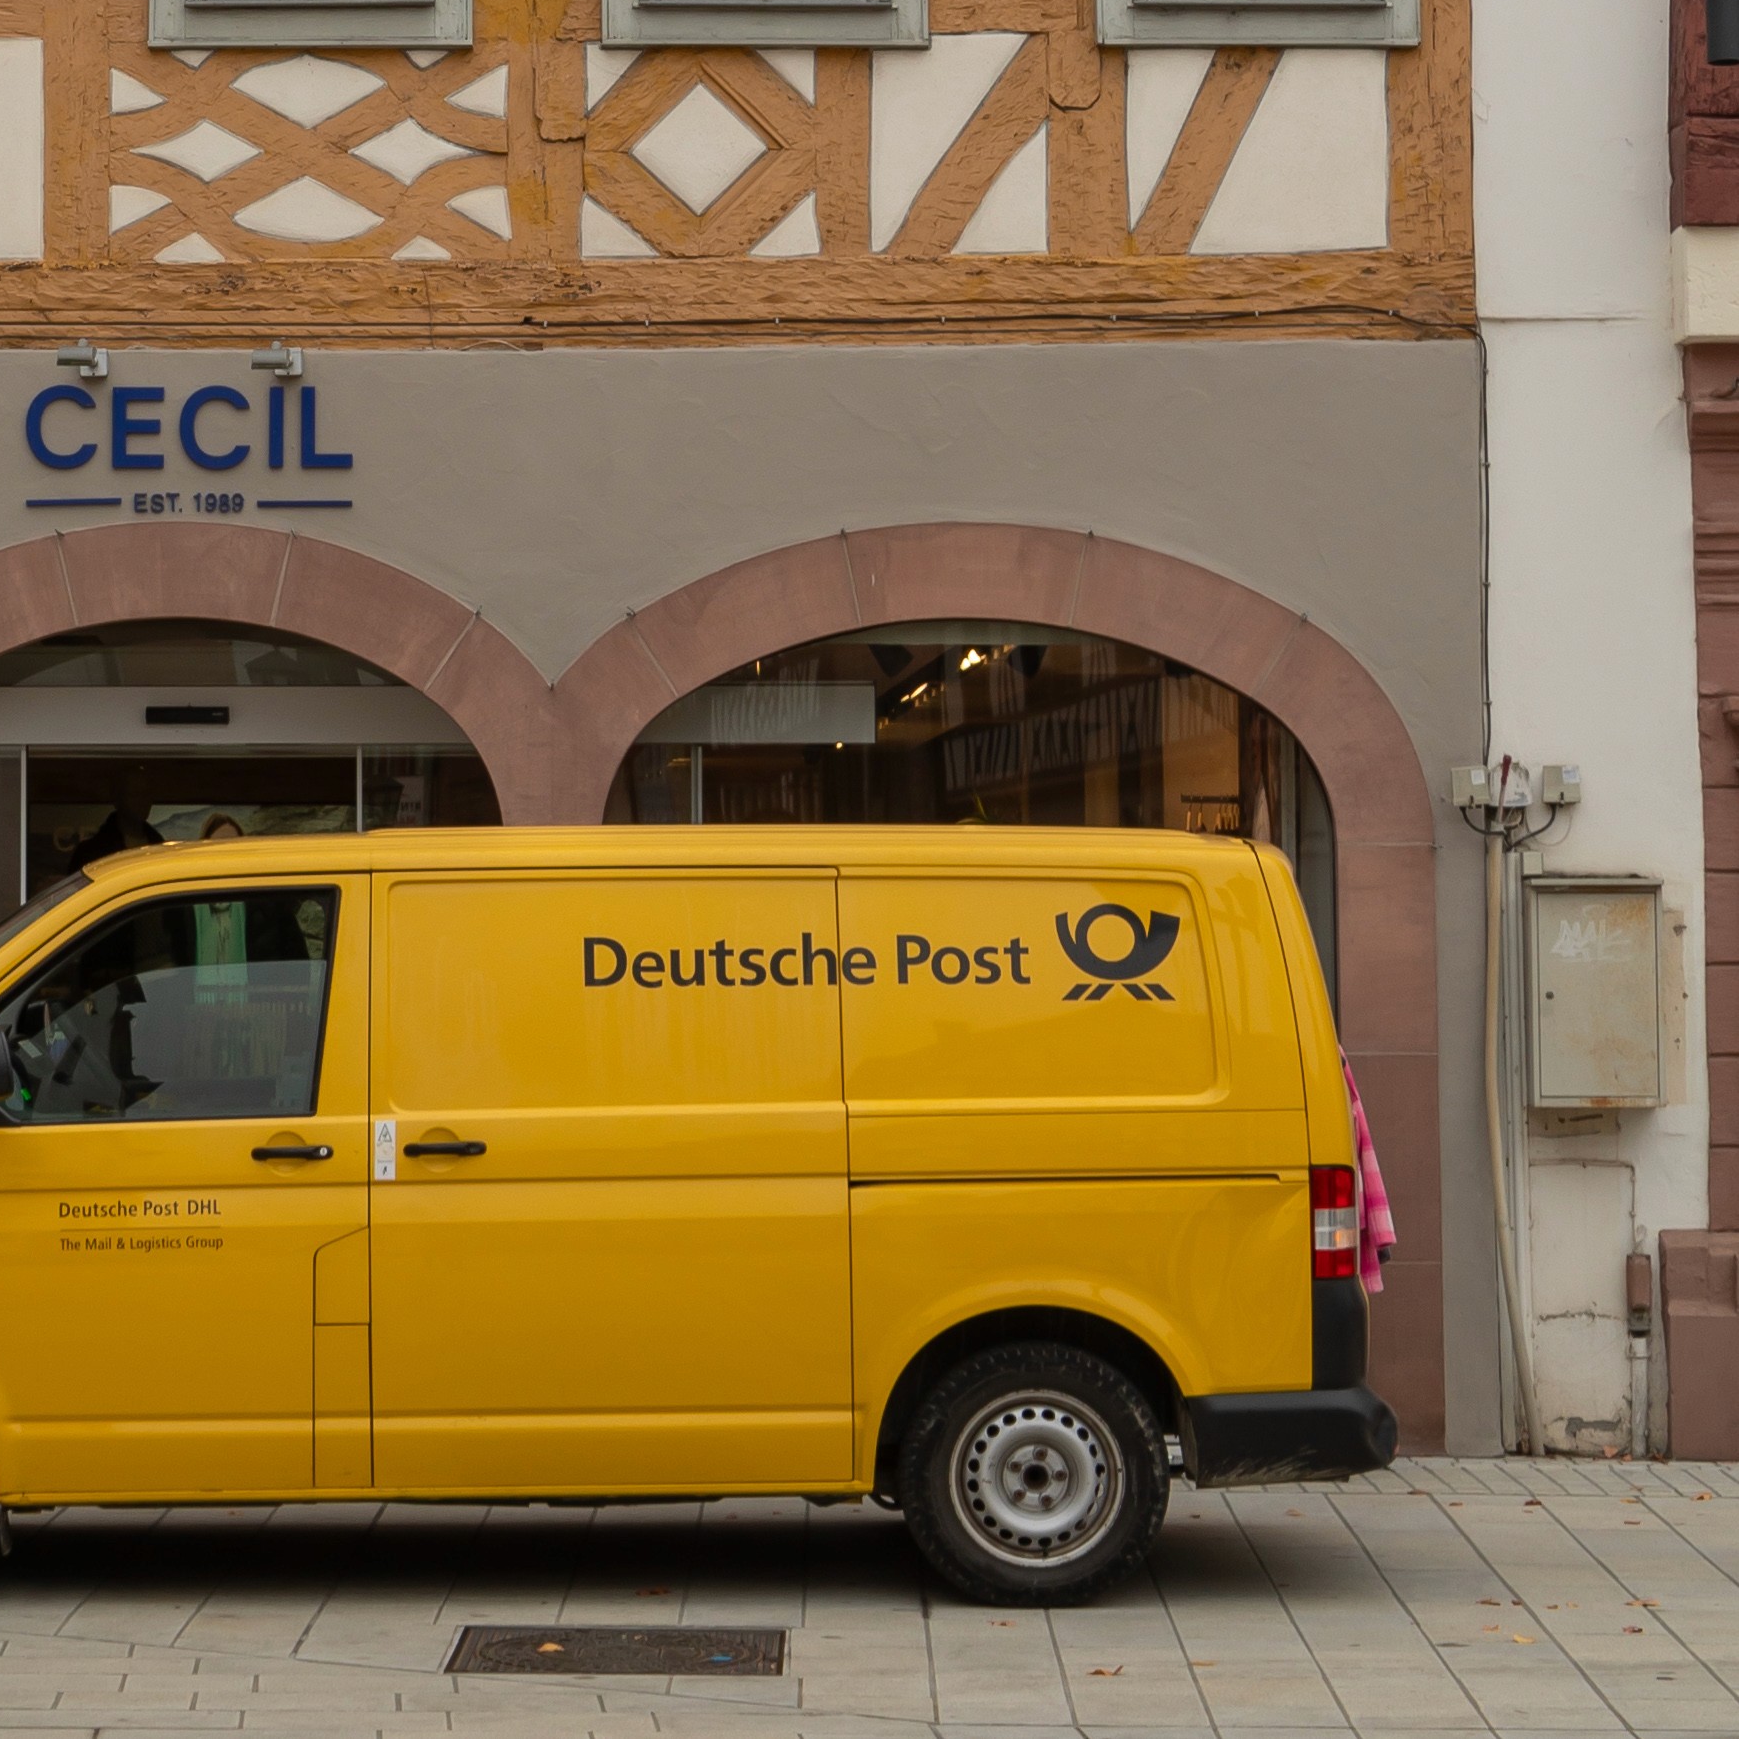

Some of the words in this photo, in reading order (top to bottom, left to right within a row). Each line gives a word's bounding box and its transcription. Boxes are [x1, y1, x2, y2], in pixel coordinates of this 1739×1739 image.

[25, 384, 353, 470] CECIL
[133, 493, 183, 513] EST.
[193, 493, 244, 514] 1989
[583, 932, 877, 988] Deutsche
[896, 934, 1031, 986] Post
[59, 1201, 138, 1218] Deutsche
[143, 1200, 179, 1216] Post
[188, 1199, 221, 1215] DHL
[61, 1238, 81, 1251] The
[85, 1237, 112, 1251] Mail
[117, 1237, 125, 1250] &
[130, 1236, 182, 1252] Logistics
[186, 1236, 223, 1251] Group
